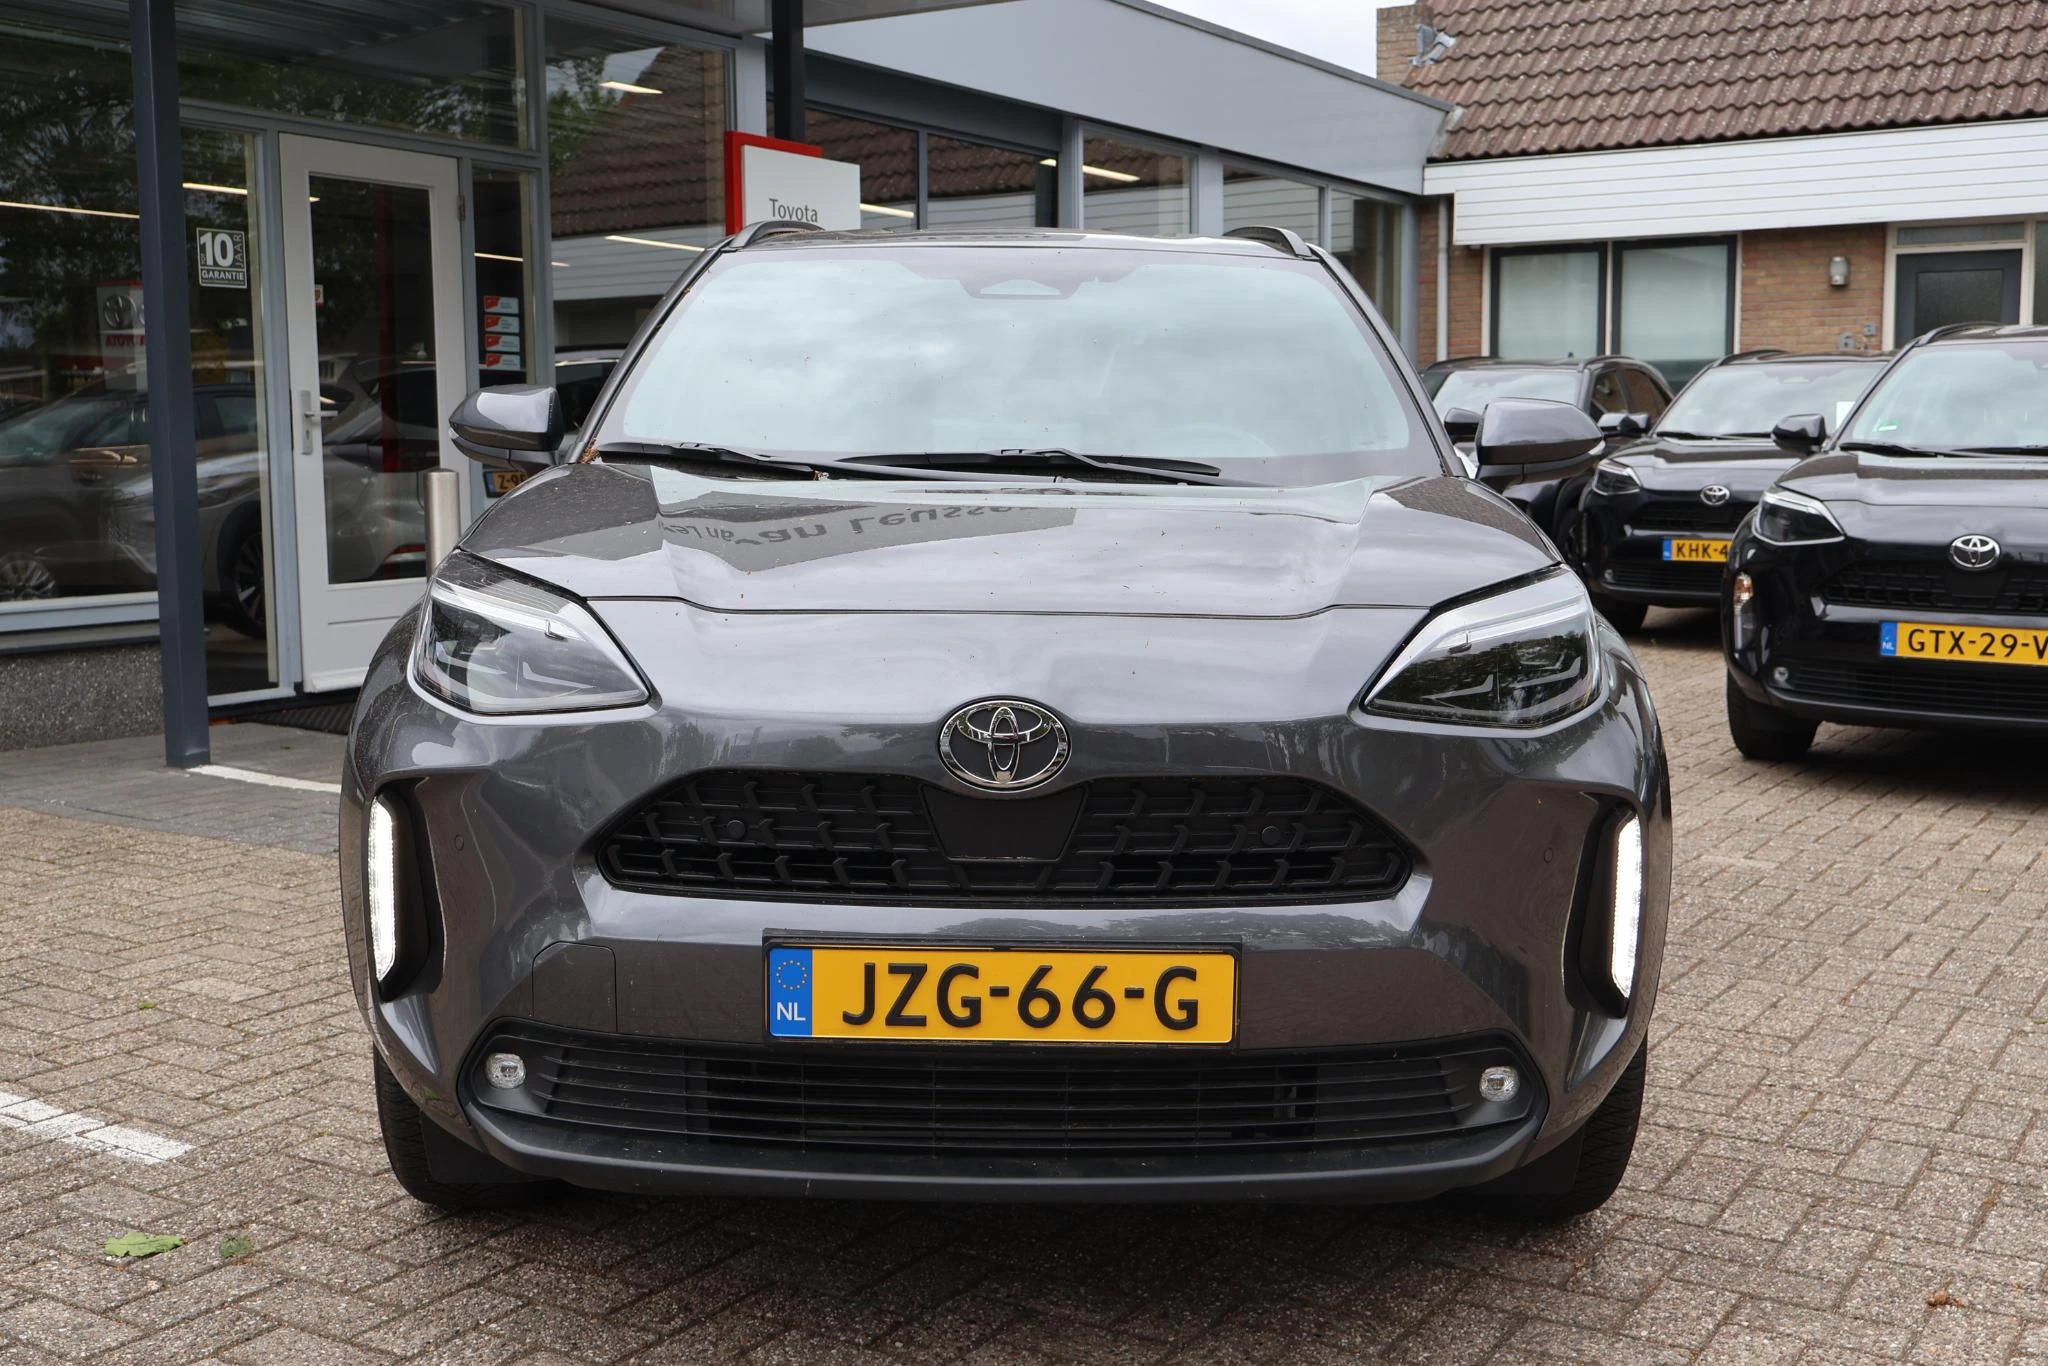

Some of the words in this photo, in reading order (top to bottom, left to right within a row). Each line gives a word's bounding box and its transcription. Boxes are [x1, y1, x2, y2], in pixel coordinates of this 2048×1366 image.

[768, 198, 818, 222] Toyota
[200, 231, 234, 267] 10
[233, 234, 243, 268] JAAR
[201, 270, 244, 280] GARANTIE
[1908, 628, 2048, 660] GTX-29-V
[776, 1001, 806, 1021] NL
[842, 962, 1198, 1030] JZG-66-G
